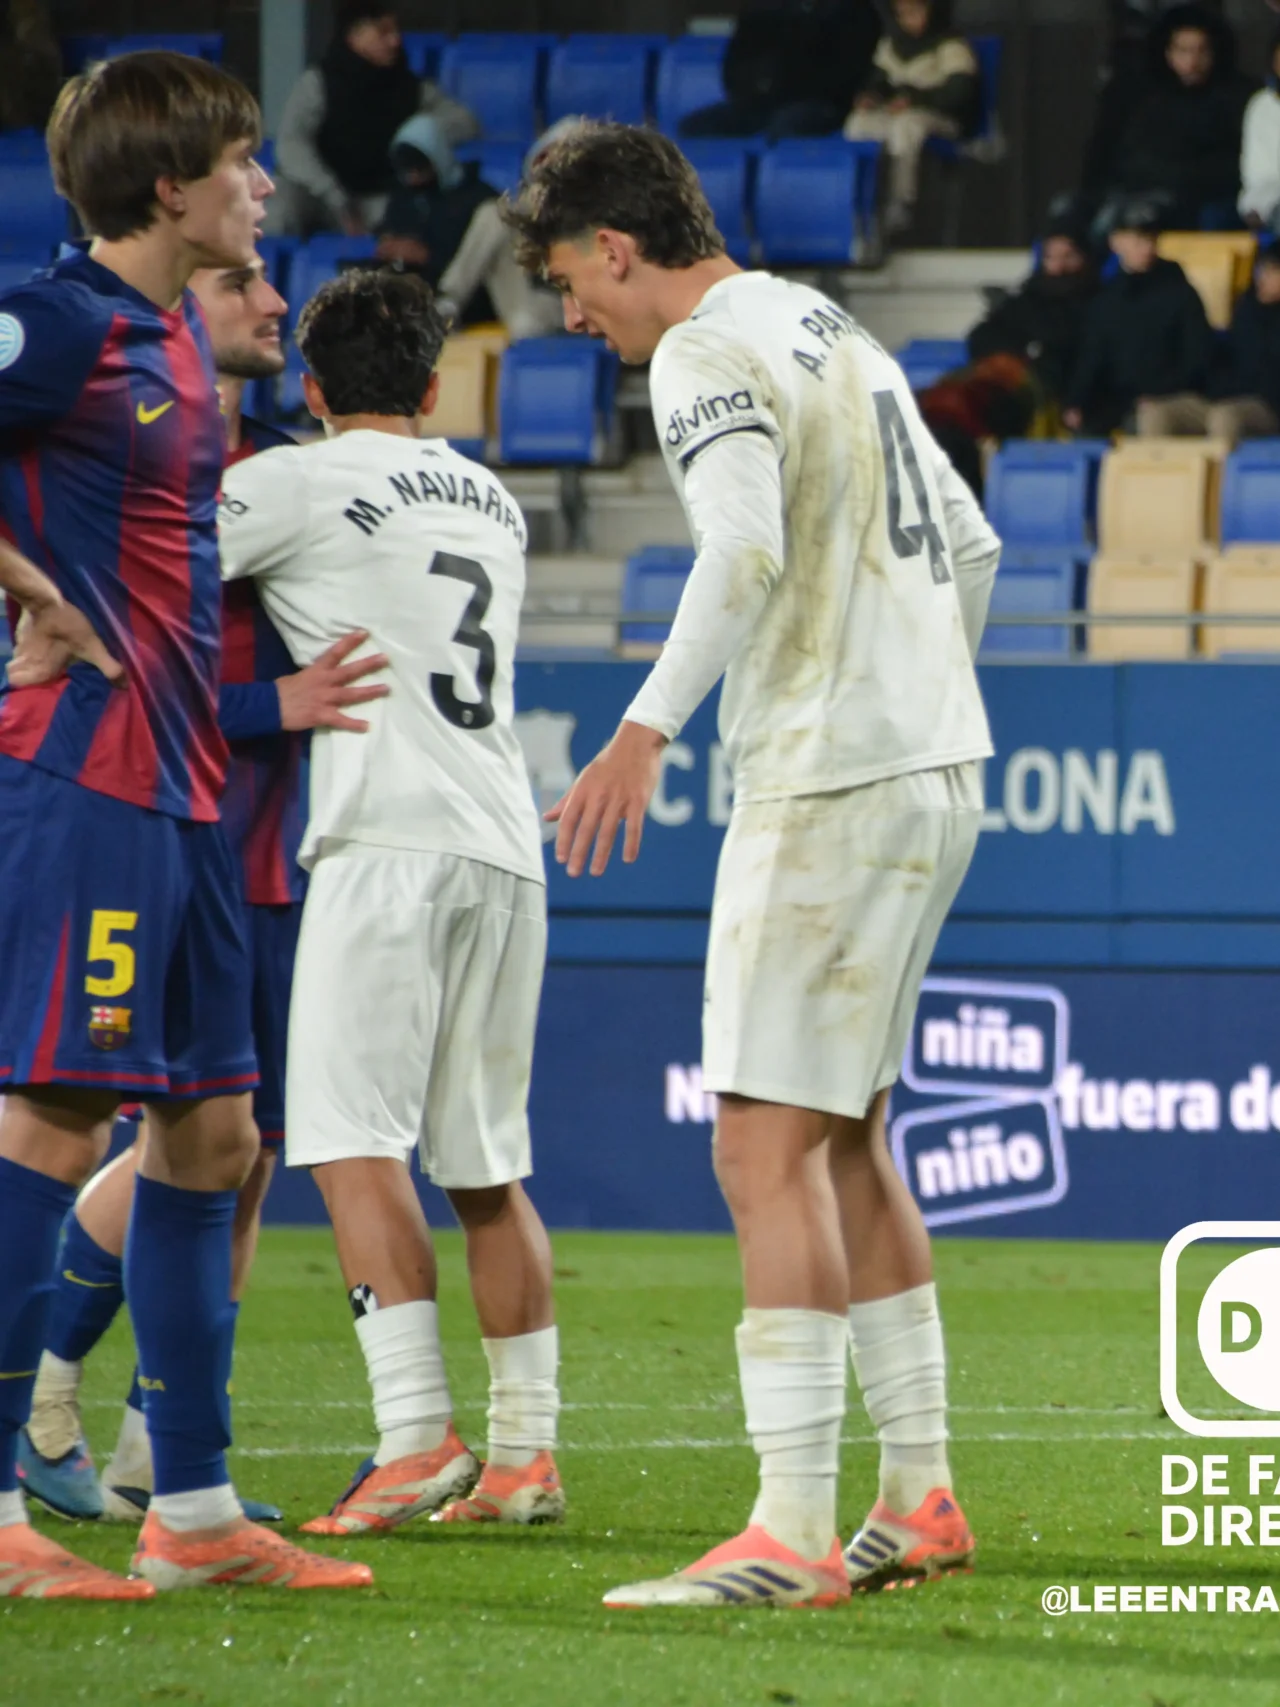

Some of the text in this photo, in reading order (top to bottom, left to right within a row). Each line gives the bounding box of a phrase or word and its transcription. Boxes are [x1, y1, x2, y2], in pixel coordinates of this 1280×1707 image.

[792, 347, 827, 382] A.
[667, 390, 755, 446] divina
[343, 471, 526, 556] M. NAVARR
[872, 389, 953, 586] 4
[427, 550, 496, 730] 3
[85, 910, 138, 996] 5
[922, 1003, 1044, 1074] niña
[1056, 1062, 1220, 1131] fuera
[916, 1122, 1044, 1198] niño
